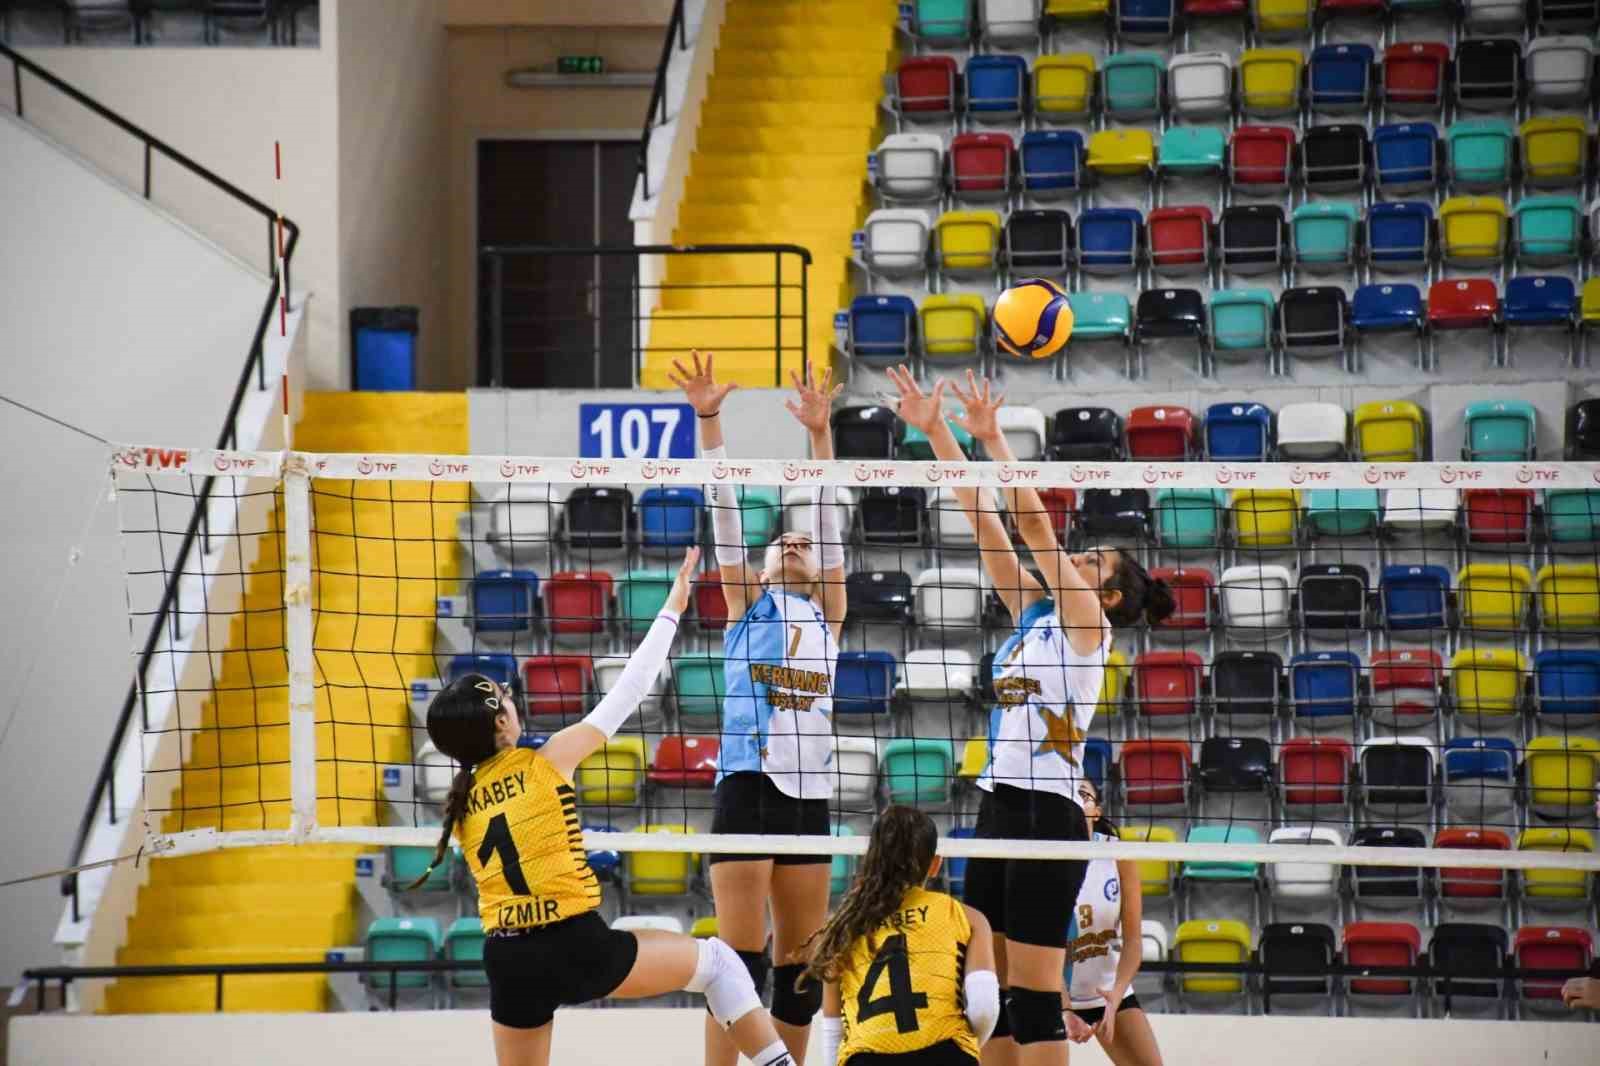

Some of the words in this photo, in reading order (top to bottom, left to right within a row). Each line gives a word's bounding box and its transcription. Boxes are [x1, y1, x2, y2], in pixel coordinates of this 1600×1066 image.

[591, 408, 681, 459] 107
[144, 448, 187, 468] TVF
[232, 459, 256, 468] TVF
[376, 463, 398, 472] TVF
[447, 464, 469, 474] TVF
[518, 465, 540, 475] TVF
[588, 466, 610, 475] TVF
[659, 467, 681, 476] TVF
[730, 468, 752, 476] TVF
[801, 469, 823, 478] TVF
[873, 469, 895, 478] TVF
[944, 470, 966, 479] TVF
[1015, 470, 1037, 479] TVF
[1087, 470, 1110, 479] TVF
[1161, 471, 1183, 479] TVF
[1234, 472, 1256, 480] TVF
[1308, 472, 1331, 480] TVF
[1382, 471, 1407, 480] TVF
[1460, 470, 1482, 480] TVF
[1535, 471, 1558, 480] TVF
[789, 624, 802, 657] 7
[477, 812, 531, 896] 1
[498, 896, 560, 928] İZMİR
[1078, 904, 1093, 929] 3
[857, 933, 929, 1034] 4
